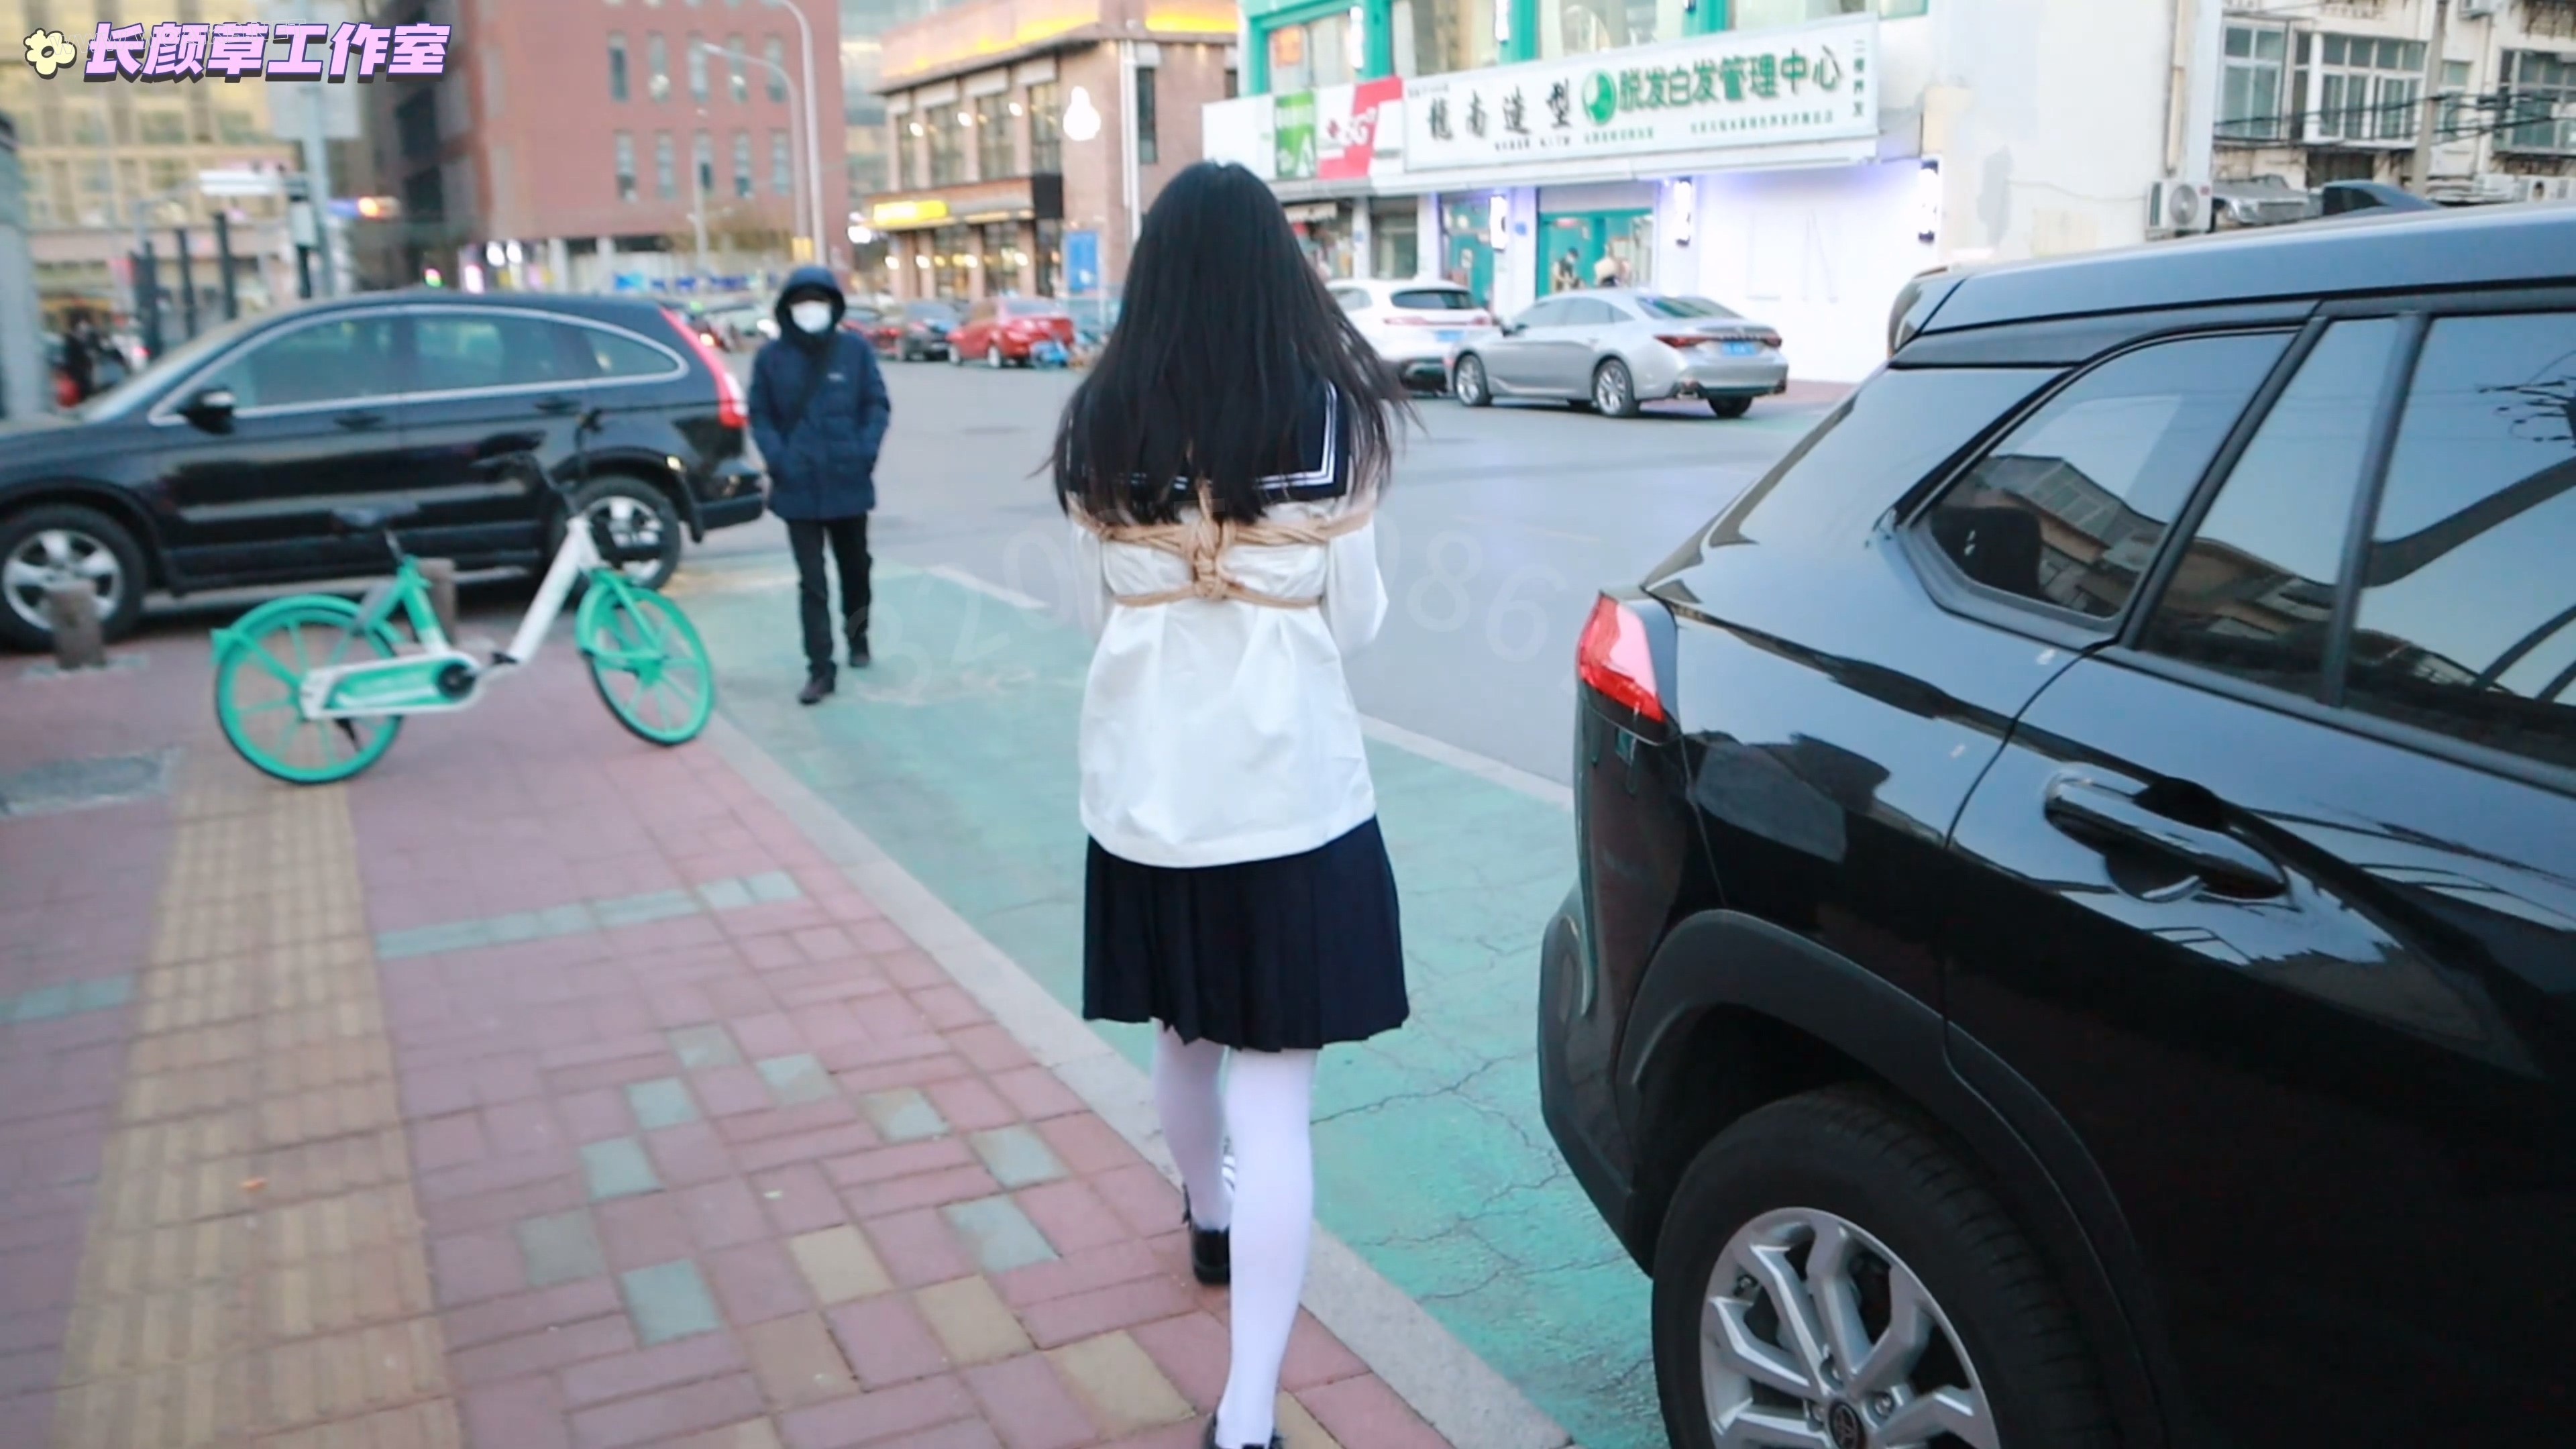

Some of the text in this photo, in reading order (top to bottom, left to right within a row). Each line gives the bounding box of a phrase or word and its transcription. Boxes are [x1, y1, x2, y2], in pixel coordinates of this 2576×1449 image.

[1619, 45, 1843, 112] 脱发白发管理中心
